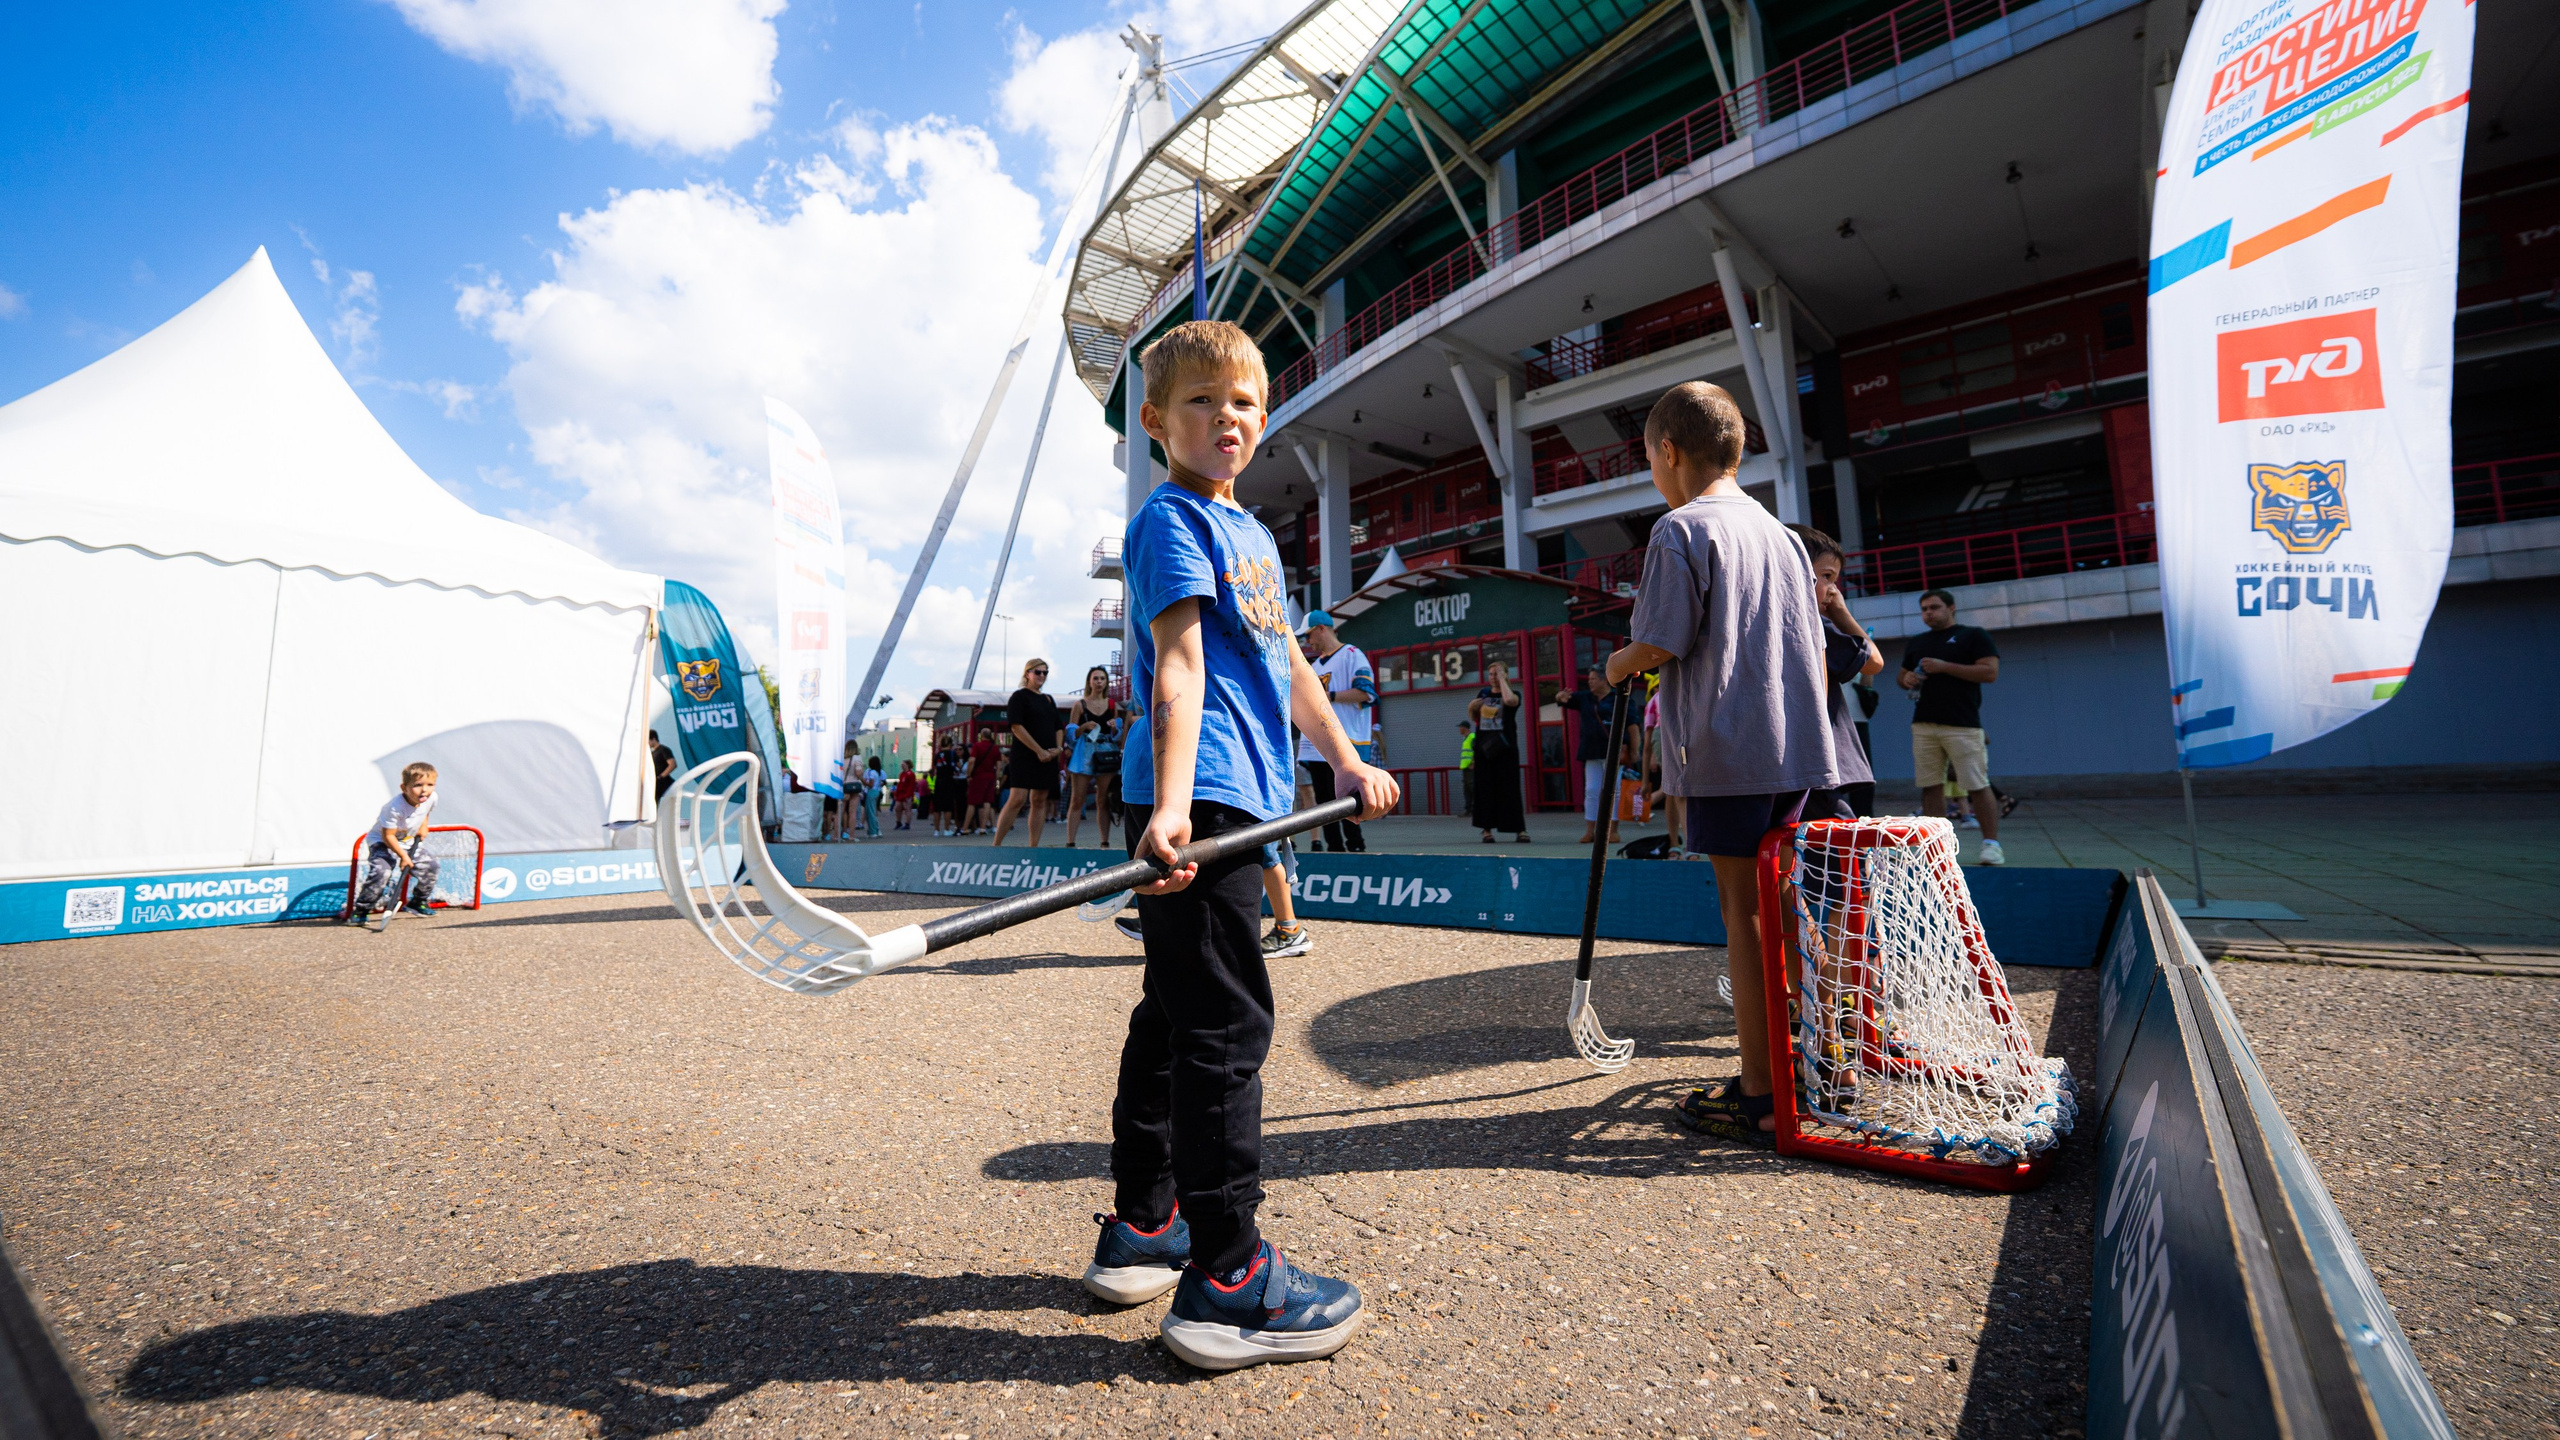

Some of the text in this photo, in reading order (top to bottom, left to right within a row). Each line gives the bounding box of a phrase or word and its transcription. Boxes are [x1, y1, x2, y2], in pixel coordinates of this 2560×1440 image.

[2217, 5, 2295, 66] ПРАЗДНИК
[2222, 0, 2292, 46] СПОРТИВ
[2212, 0, 2379, 108] ДОСТИ
[2274, 0, 2415, 102] ЦЕЛИ!
[2200, 44, 2406, 169] В ЧЕСТЬ ДНЯ ЖЕЛЕЗНОДОРОЖНИКА
[2202, 89, 2257, 133] ДЛЯ ВСЕЙ
[2316, 114, 2326, 130] 3
[2327, 82, 2389, 123] АВГУСТА
[2197, 106, 2253, 149] СЕМЬИ
[2215, 287, 2380, 326] ГЕНЕРАЛЬНЫЙ ПАРТНЕР
[2261, 424, 2294, 437] ОАО
[2235, 561, 2372, 575] ХОККЕЙНЫЙ КЛУБ
[1414, 592, 1471, 628] СЕКТОР
[2236, 576, 2380, 621] СОЧИ
[1431, 625, 1454, 638] GATE
[1431, 651, 1463, 682] 13
[131, 894, 288, 924] НА ХОККЕЙ
[134, 877, 288, 902] ЗАПИСАТЬСЯ
[1477, 912, 1488, 921] 11
[1503, 913, 1515, 922] 12
